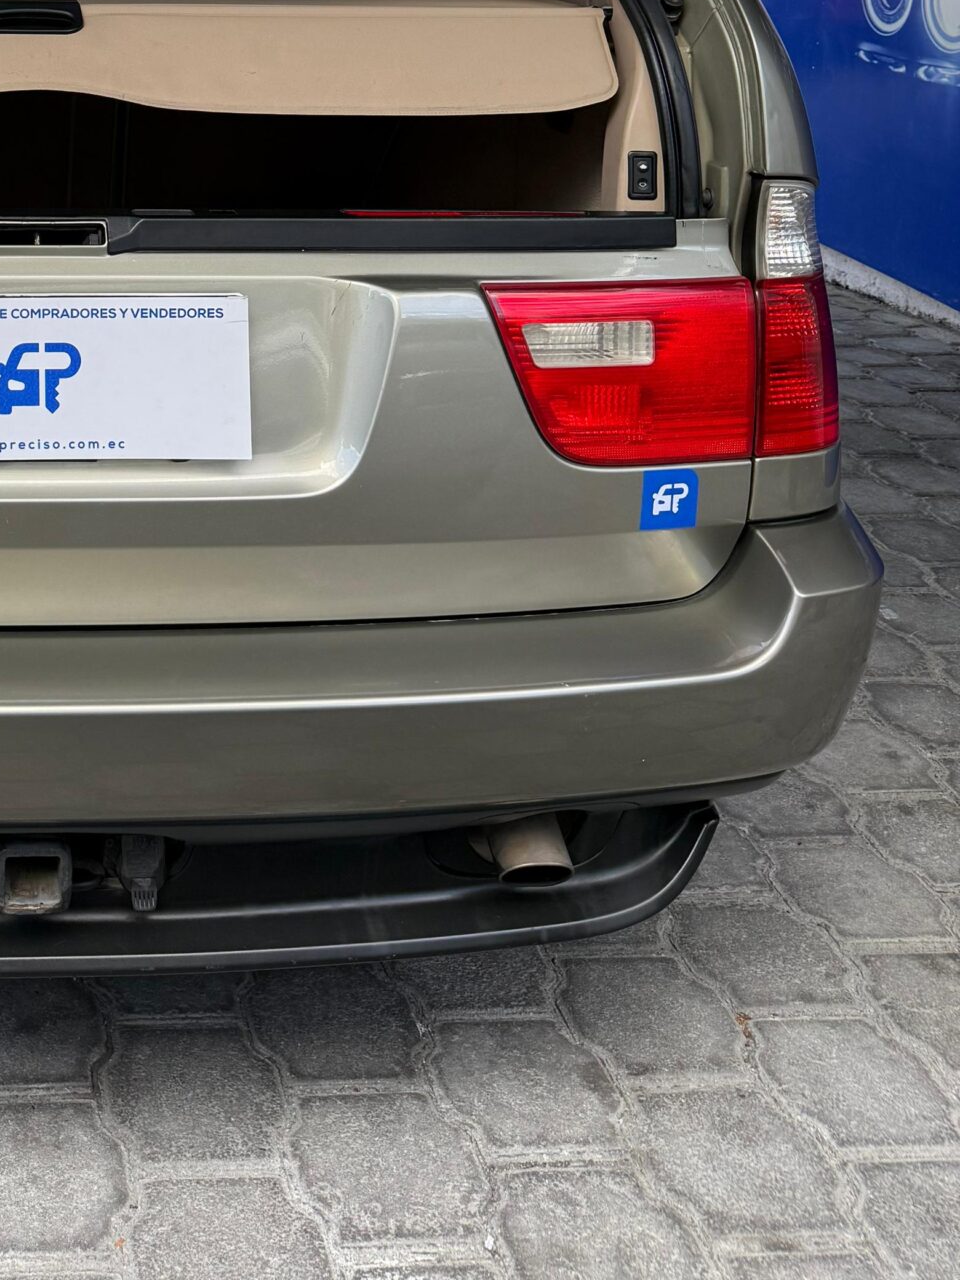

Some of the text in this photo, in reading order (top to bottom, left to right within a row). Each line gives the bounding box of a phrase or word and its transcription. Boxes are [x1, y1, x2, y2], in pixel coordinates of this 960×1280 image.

[11, 308, 117, 319] COMPRADORES
[119, 308, 129, 319] Y
[130, 307, 224, 319] VENDEDORES
